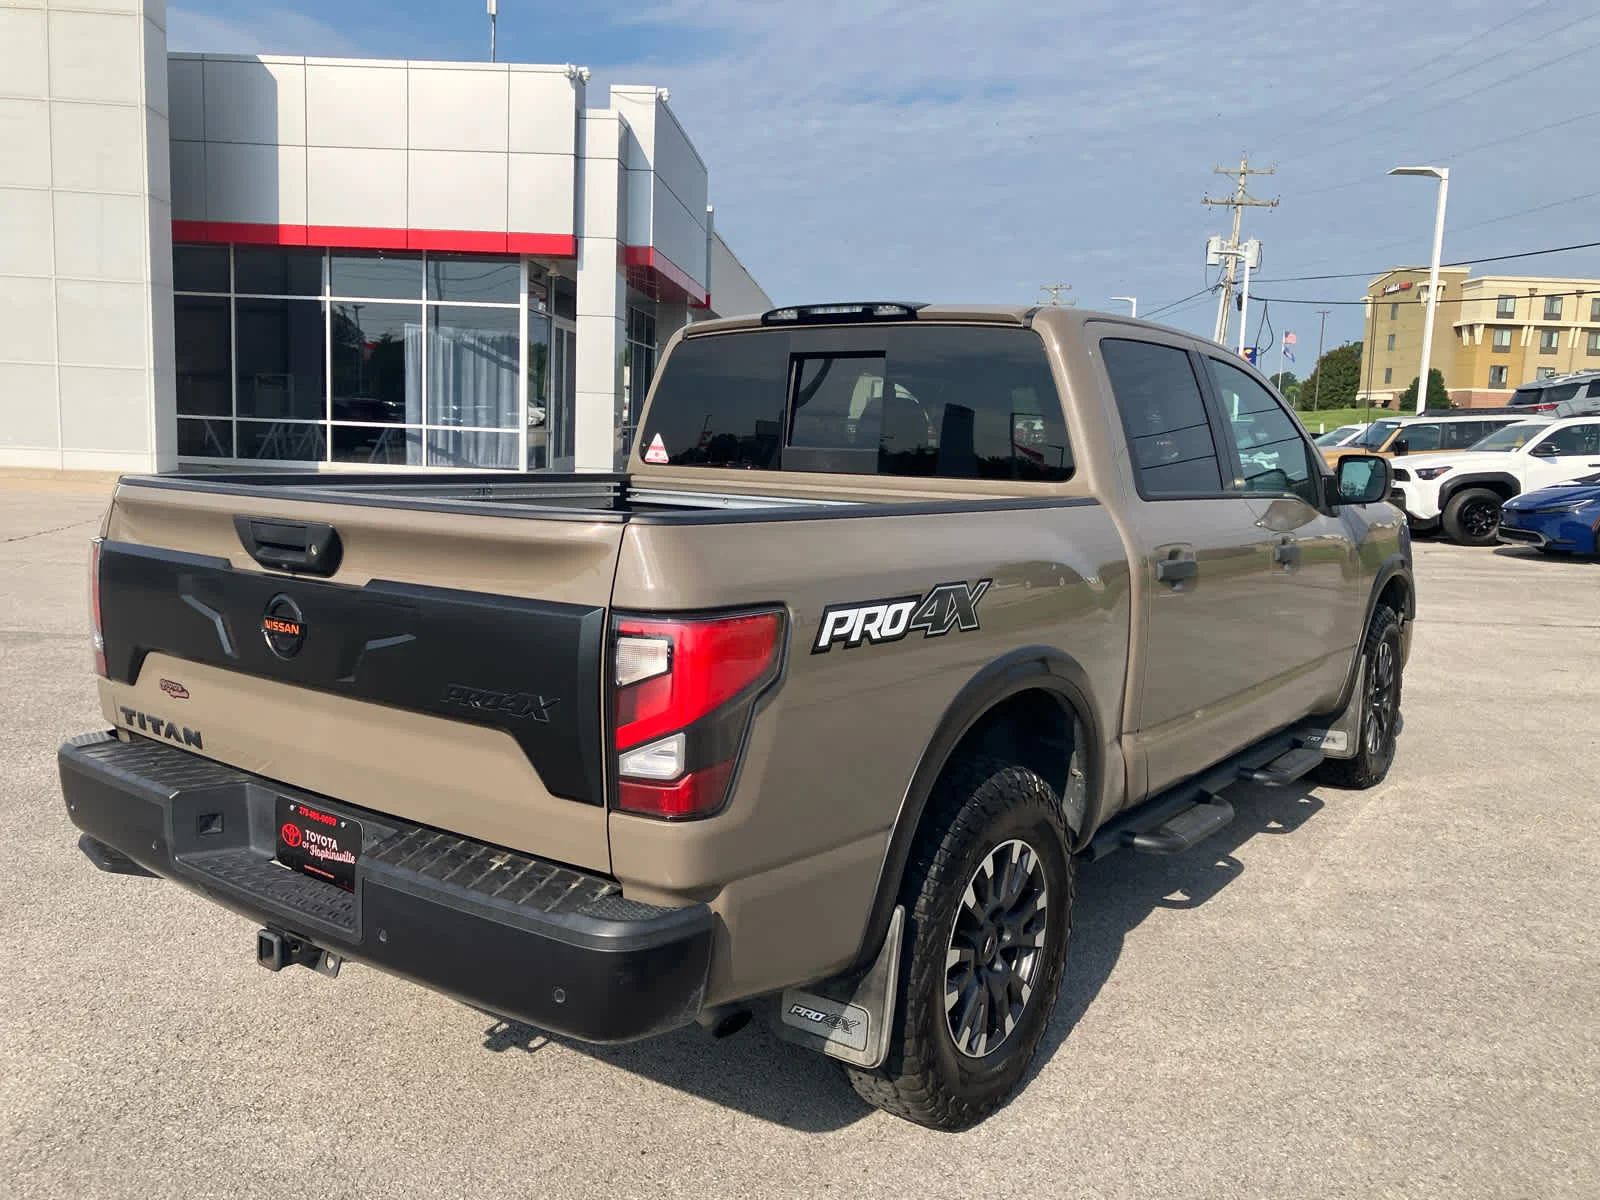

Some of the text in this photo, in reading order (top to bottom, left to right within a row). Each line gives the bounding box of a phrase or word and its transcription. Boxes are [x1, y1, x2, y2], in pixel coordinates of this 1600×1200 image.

[264, 618, 300, 635] NISSAN
[120, 706, 203, 750] TITAN
[305, 829, 338, 851] TOYOTA
[309, 844, 356, 864] Hopkinsville
